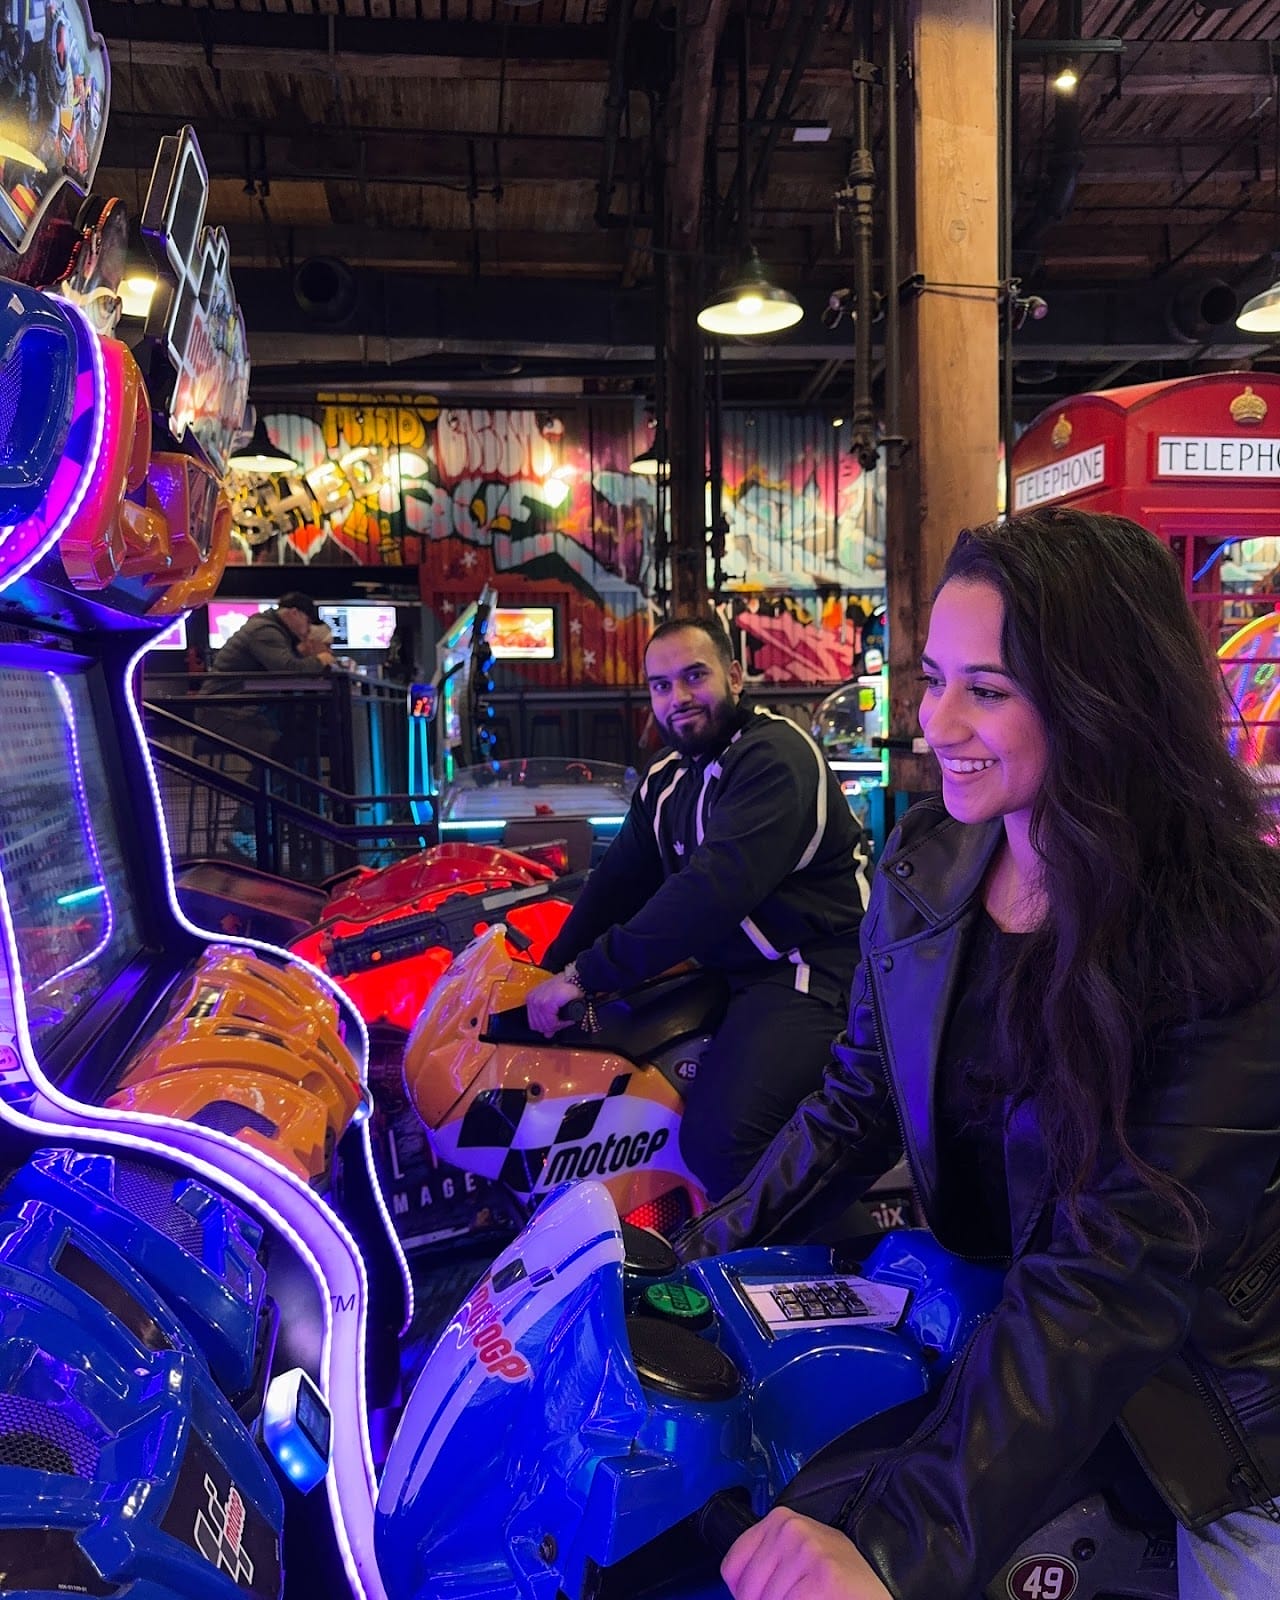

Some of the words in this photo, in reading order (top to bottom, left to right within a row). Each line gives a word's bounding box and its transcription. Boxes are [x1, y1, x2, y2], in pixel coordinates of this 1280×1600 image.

[1162, 442, 1280, 471] TELEPH
[1017, 449, 1103, 506] TELEPHONE
[678, 1062, 697, 1078] 49
[1022, 1565, 1065, 1600] 49
